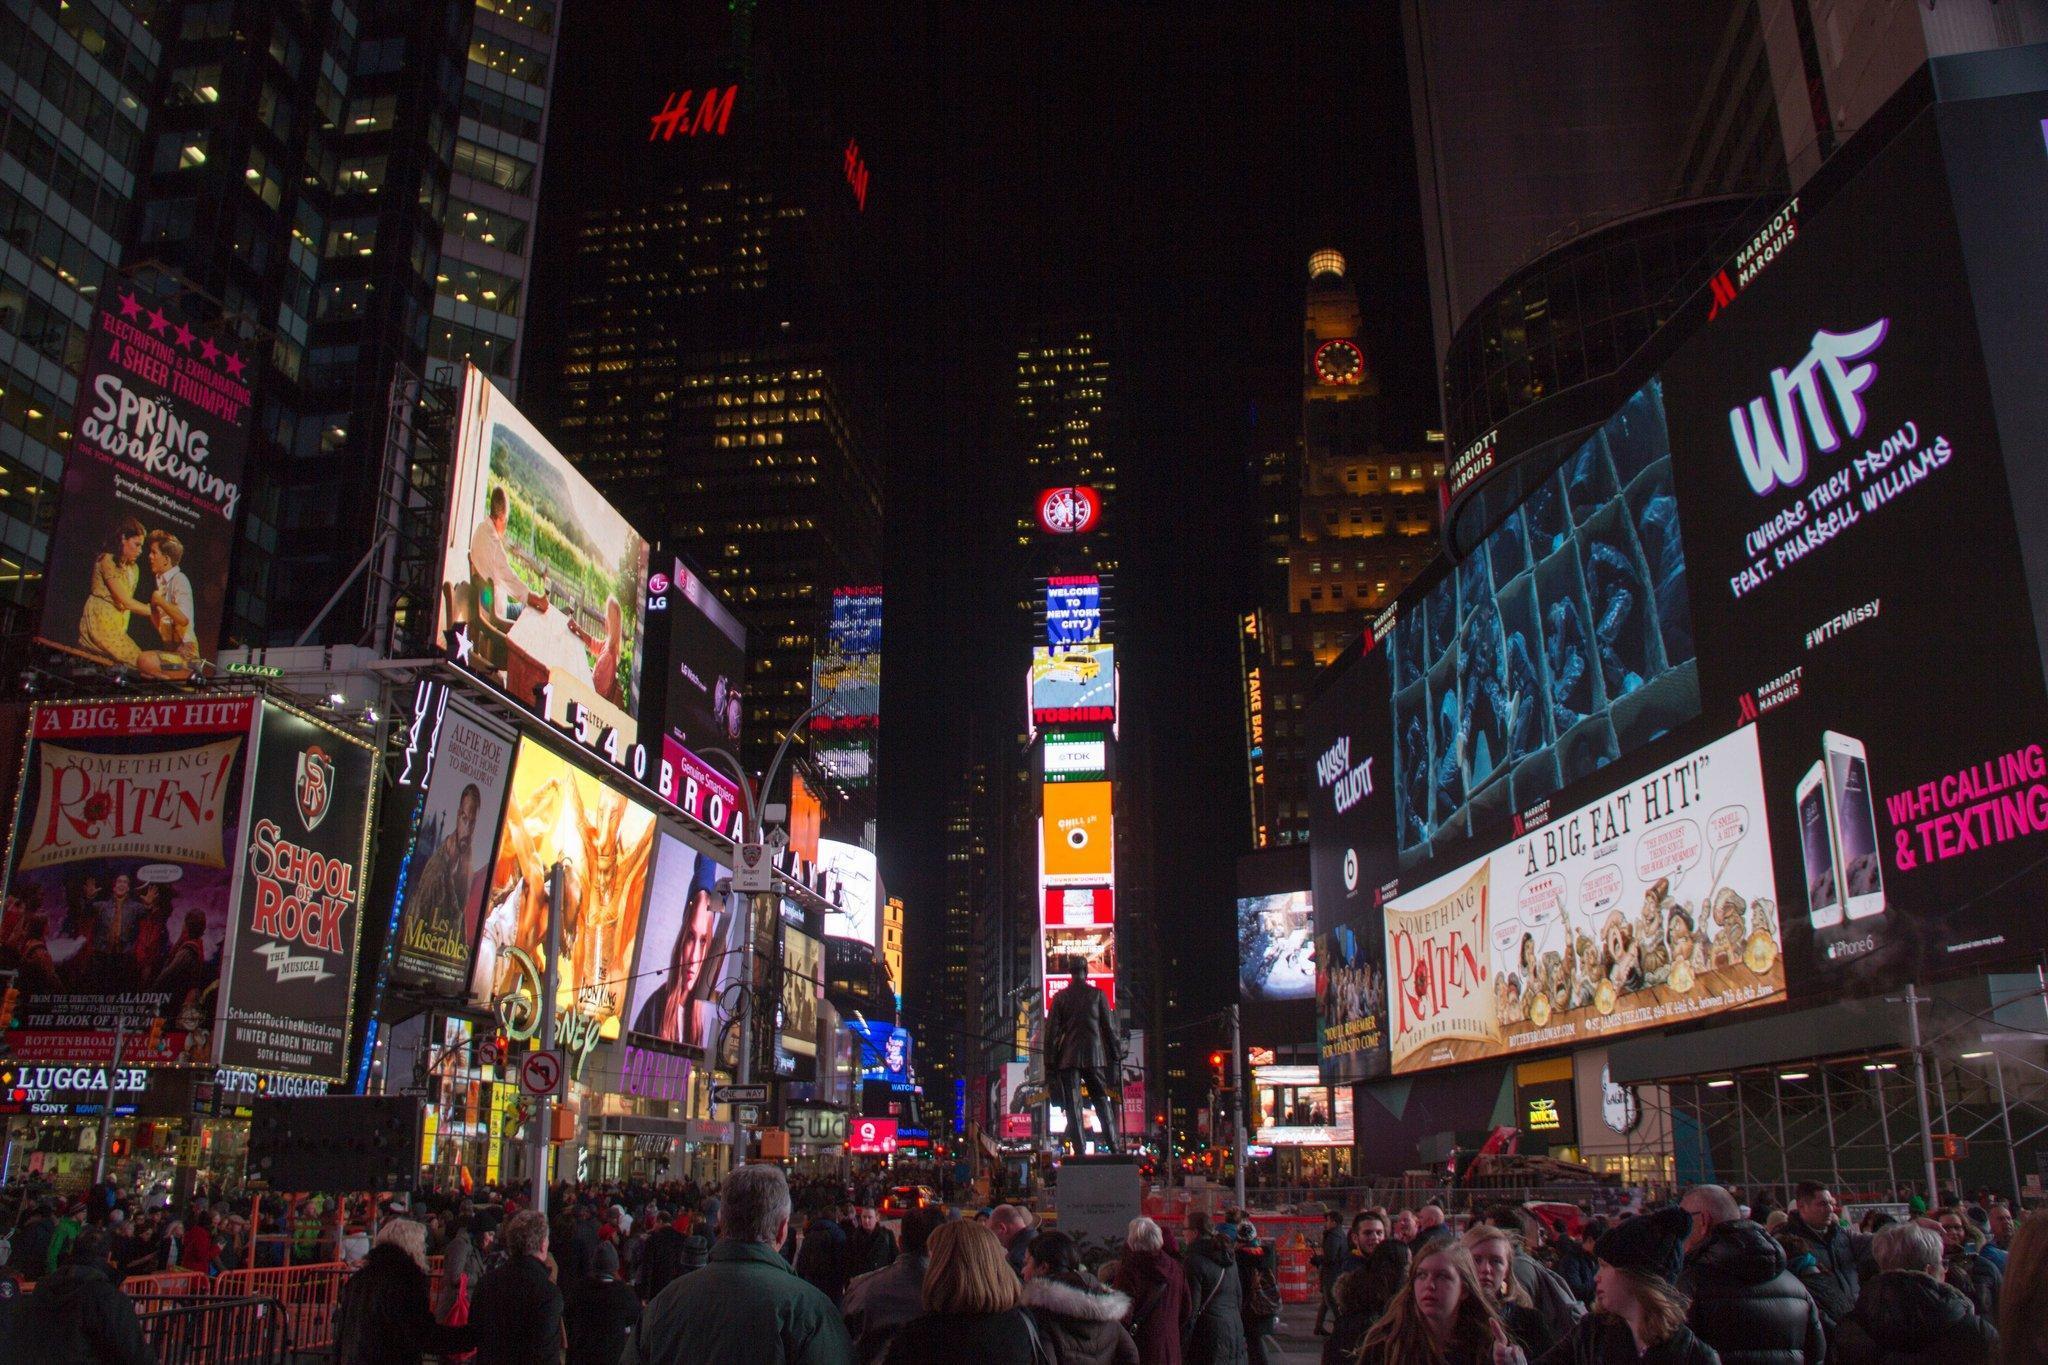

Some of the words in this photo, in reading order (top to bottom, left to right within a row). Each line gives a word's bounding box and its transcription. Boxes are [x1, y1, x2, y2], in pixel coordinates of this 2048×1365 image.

[650, 85, 738, 141] H&M
[1737, 197, 1799, 269] MARRIOTT
[1739, 224, 1795, 287] MARQUIS
[109, 339, 121, 364] A
[122, 345, 170, 389] SHEER
[93, 374, 209, 462] SPRING
[1728, 316, 1889, 497] WTF
[82, 420, 241, 520] awakening
[1861, 436, 1952, 513] WILLIAMS
[1047, 575, 1098, 586] TOSHIBA
[1048, 587, 1098, 598] WELCOME
[648, 597, 667, 610] LG
[1047, 609, 1070, 619] NEW
[1073, 608, 1100, 618] YORK
[1066, 598, 1081, 608] TO
[1062, 619, 1086, 630] CITY
[1805, 598, 1880, 650] #WTFMissy
[230, 663, 279, 677] LAMAR
[1757, 666, 1803, 698] MARRIOTT
[1248, 668, 1262, 711] TAKE
[1759, 683, 1800, 712] MARQUIS
[69, 708, 119, 731] BIG,
[128, 706, 177, 728] FAT
[1034, 707, 1113, 724] TOSHIBA
[448, 740, 473, 761] BRINGS
[451, 724, 482, 752] ALFIE
[481, 738, 503, 765] BOE
[1066, 752, 1091, 761] TDK
[66, 751, 210, 775] SOMETHING
[1886, 782, 1940, 826] WI-FI
[1940, 744, 2048, 808] CALLING
[1057, 817, 1084, 829] CHILL
[1545, 814, 1588, 868] BIG,
[1588, 789, 1633, 849] FAT
[1894, 827, 1919, 873] &
[1915, 783, 2048, 864] TEXTING
[250, 818, 357, 903] SCHOOL
[295, 883, 314, 904] OF
[250, 875, 349, 955] ROCK
[430, 906, 450, 933] Les
[1401, 886, 1475, 936] SOMETHING
[269, 951, 286, 962] THE
[1834, 939, 1866, 959] iPhone
[1865, 937, 1874, 952] 6
[281, 960, 320, 974] MUSICAL
[117, 992, 173, 1004] ALADDIN
[28, 1015, 52, 1026] THE
[55, 1015, 90, 1026] BOOK
[92, 1015, 109, 1026] OF
[228, 1006, 343, 1039] SchoolOfRockTheMusical.com
[235, 1026, 267, 1045] WINTER
[268, 1032, 301, 1050] GARDEN
[302, 1037, 334, 1055] THEATRE
[257, 1048, 273, 1059] 50TH
[281, 1052, 313, 1066] BROADWAY
[16, 1067, 147, 1091] LUGGAGE
[215, 1068, 258, 1093] GIFTS
[267, 1075, 329, 1098] LUGGAGE
[620, 1046, 693, 1100] FOREVER
[720, 1089, 737, 1098] ONE
[745, 1088, 763, 1098] WAY
[891, 1083, 915, 1093] WATCH
[31, 1103, 69, 1114] SONY
